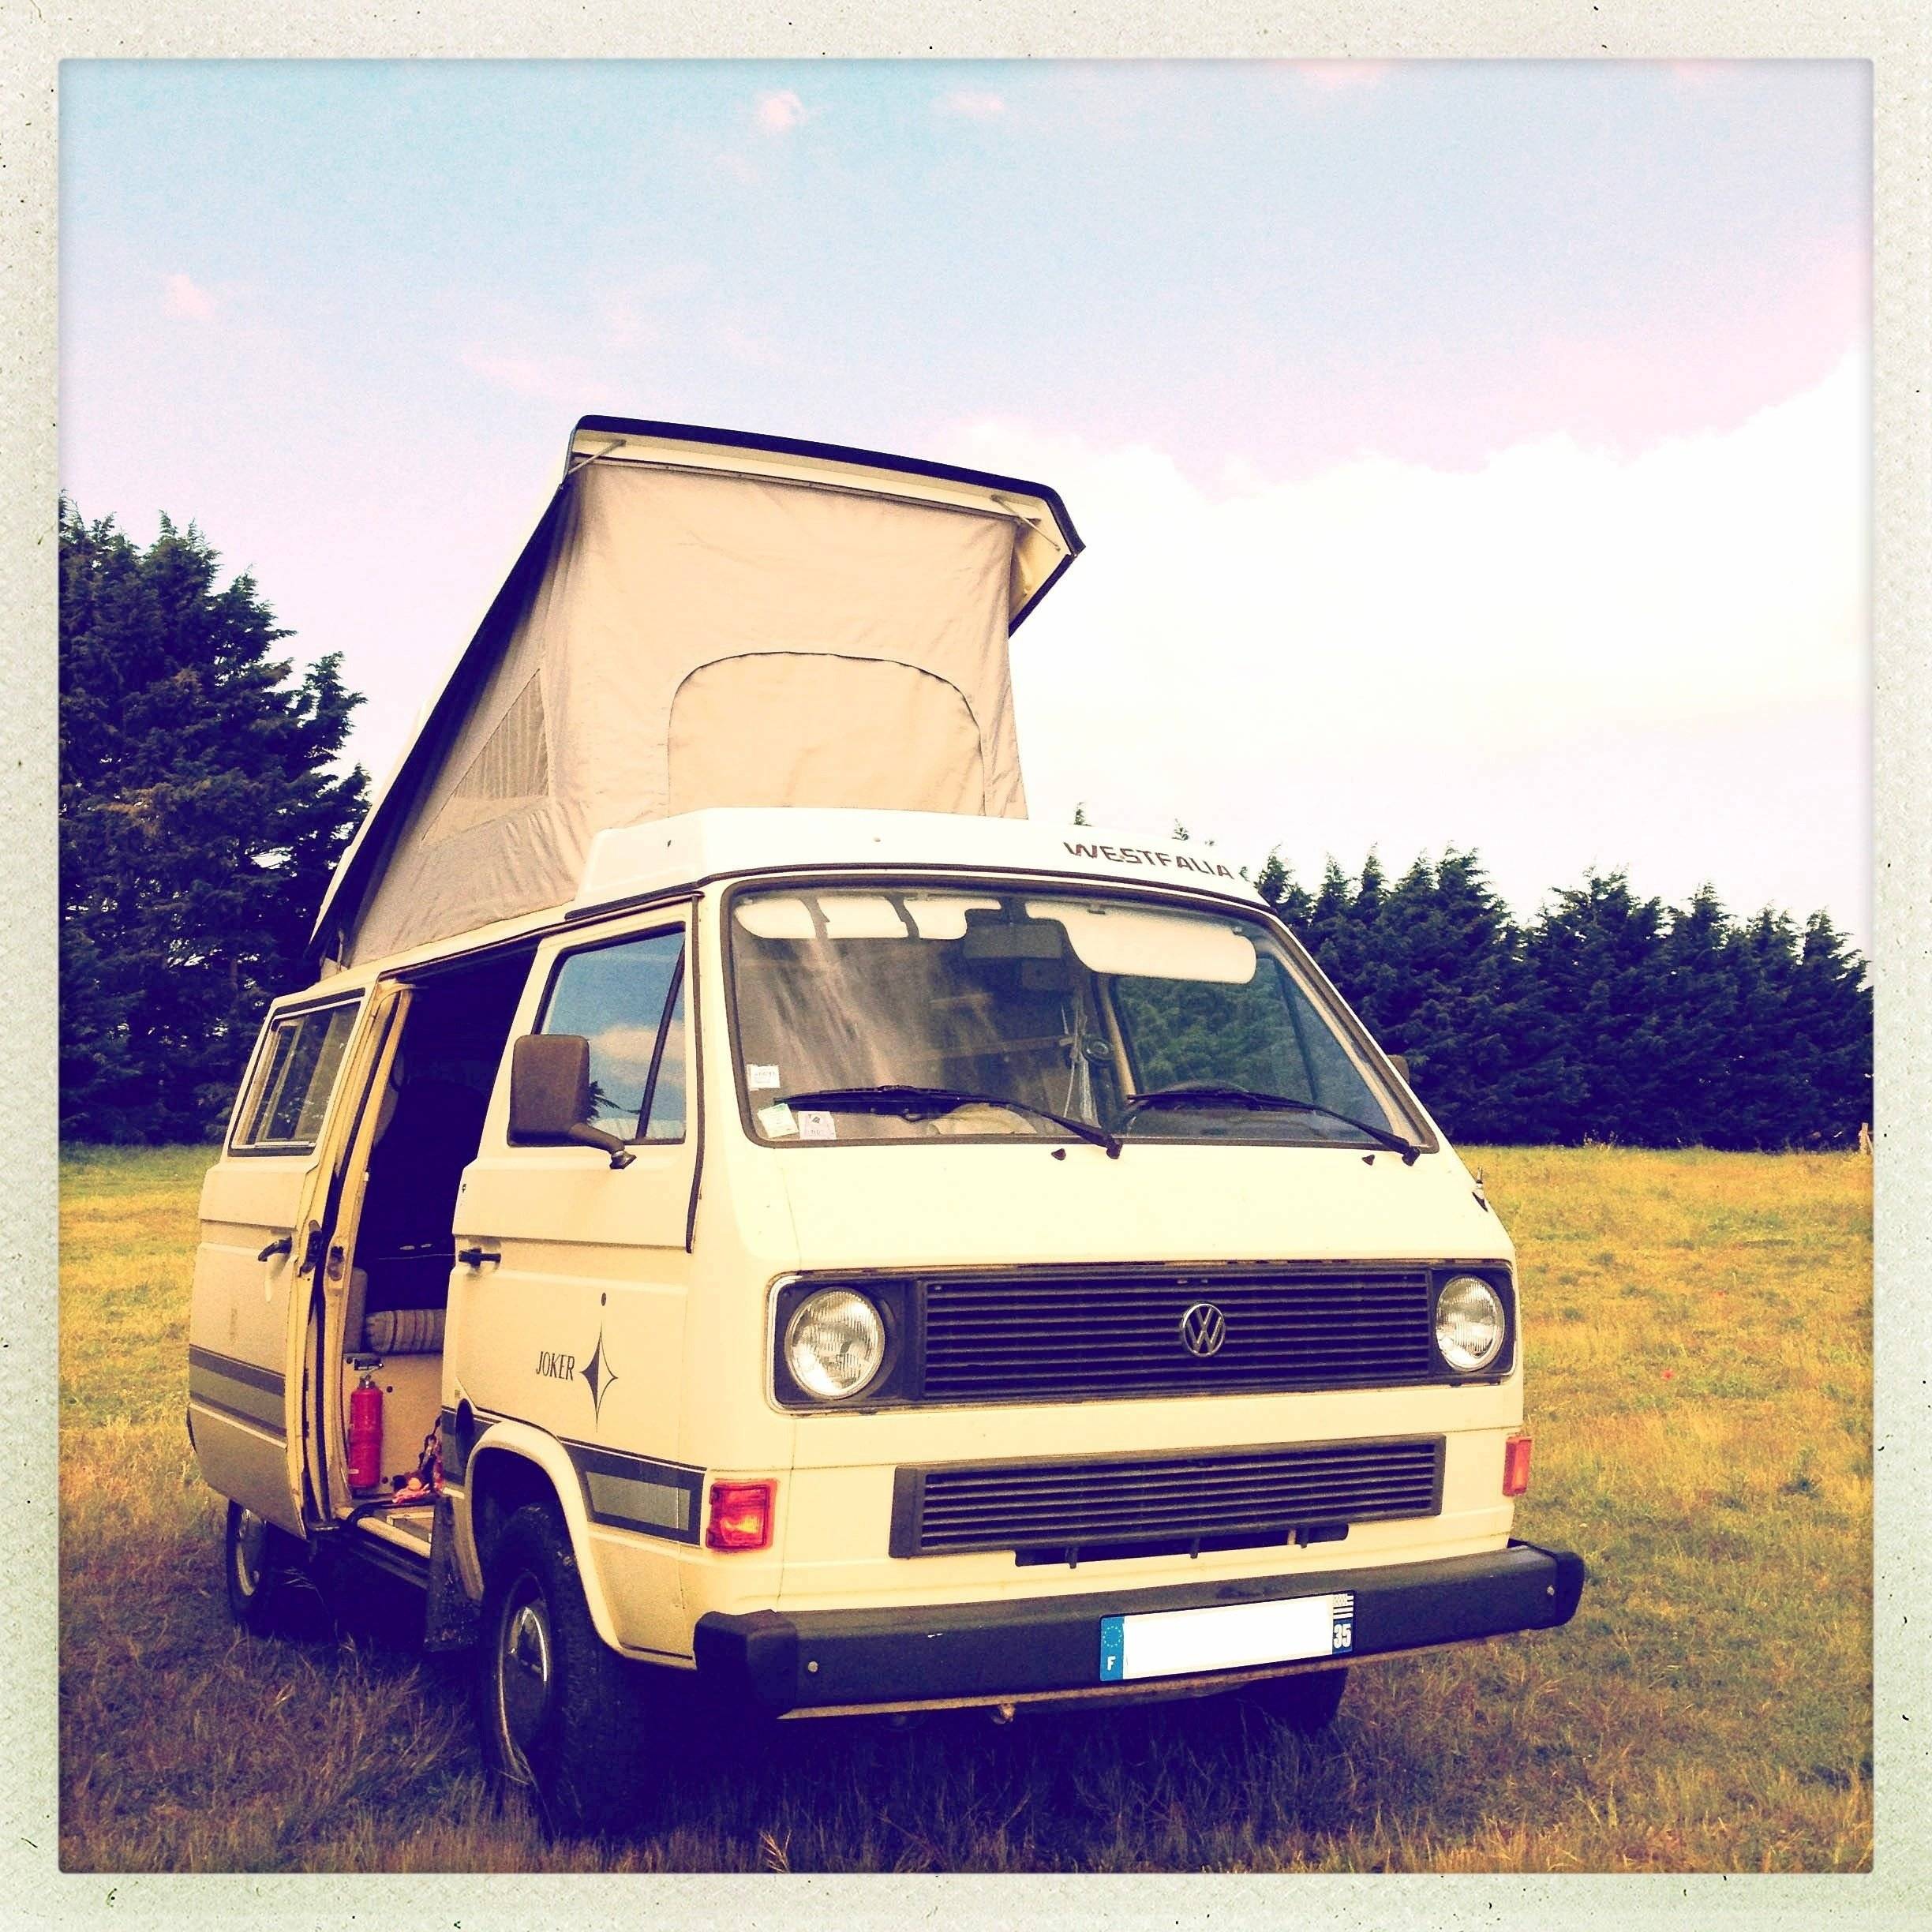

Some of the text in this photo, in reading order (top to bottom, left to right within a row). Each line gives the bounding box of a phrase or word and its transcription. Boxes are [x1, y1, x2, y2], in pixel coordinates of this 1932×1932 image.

[1063, 841, 1234, 879] WESTFALIA
[1183, 1304, 1224, 1356] VW
[536, 1350, 575, 1381] JOKER
[1333, 1623, 1352, 1649] 35
[1106, 1656, 1116, 1671] F
